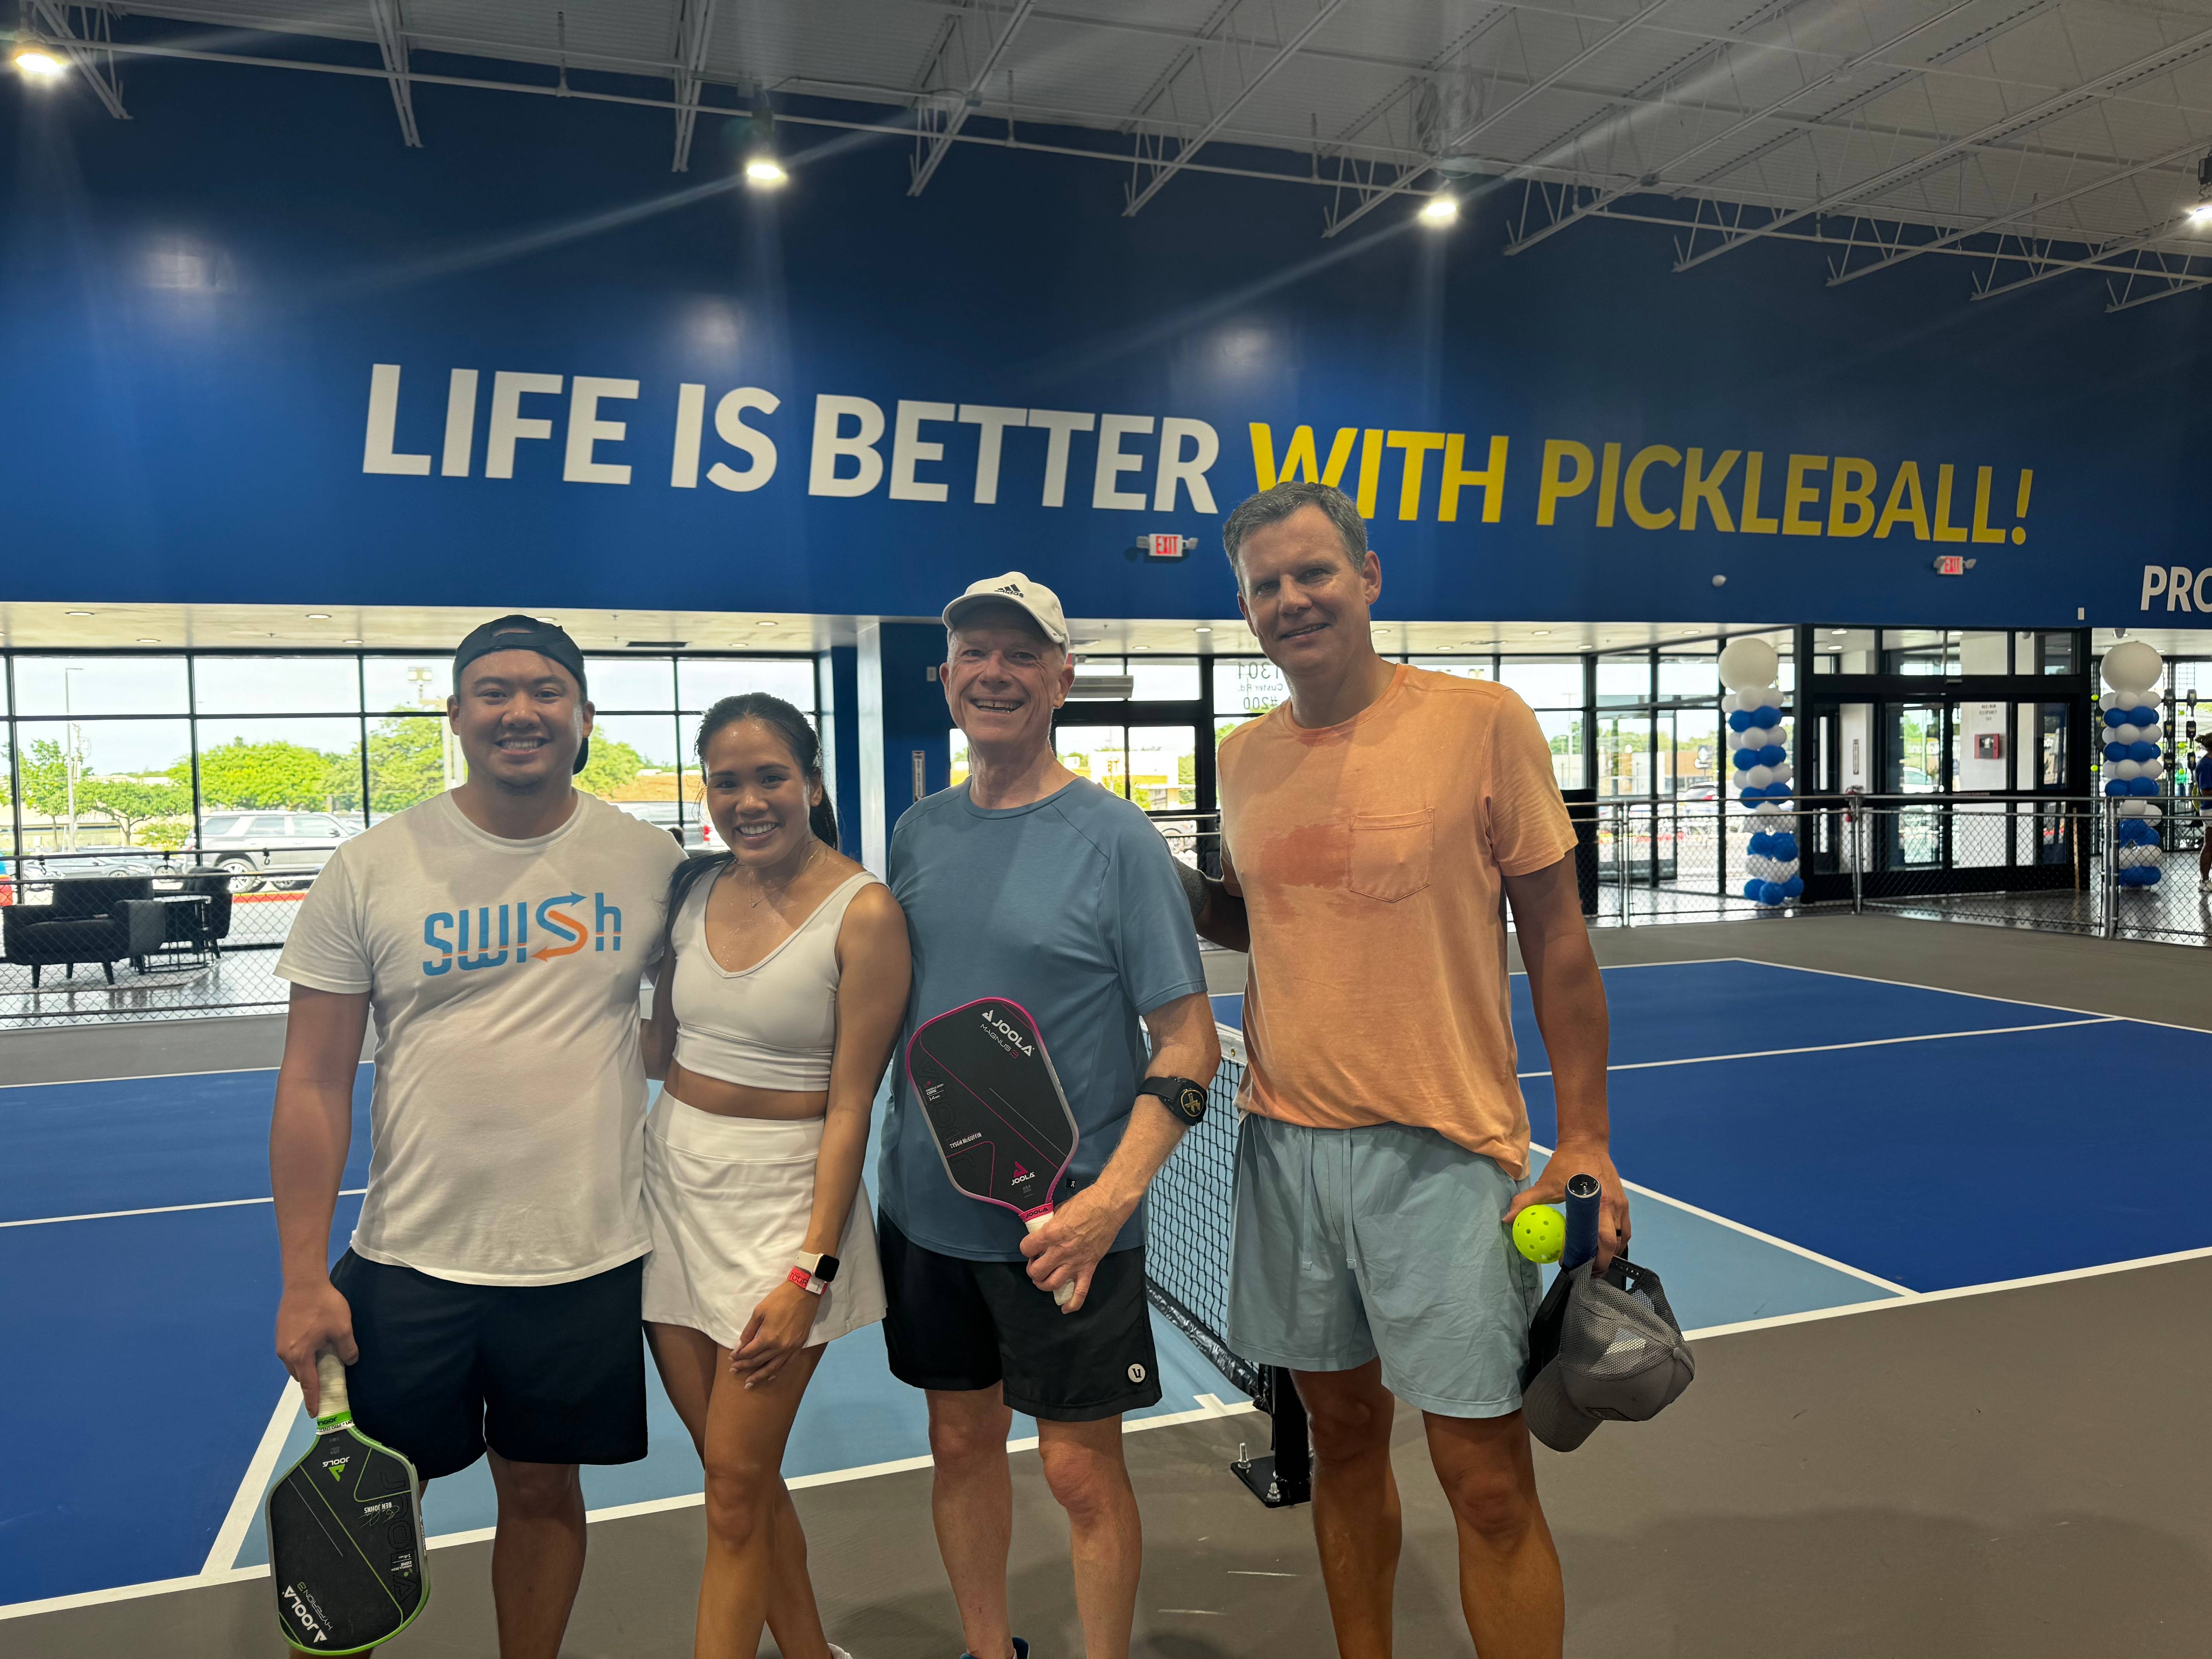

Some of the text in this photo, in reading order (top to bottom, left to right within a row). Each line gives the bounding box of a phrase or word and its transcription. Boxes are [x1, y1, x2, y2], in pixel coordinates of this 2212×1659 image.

[363, 364, 2033, 545] LIFE IS BETTER WITH PICKLEBALL!
[1156, 536, 1178, 555] EXIT
[1944, 557, 1960, 573] EXIT
[980, 1024, 1019, 1058] MAGNUS 3
[991, 1019, 1032, 1057] JOOLA
[949, 1132, 982, 1149] TYSON McGUFFIN
[1011, 1172, 1036, 1186] JOOLA
[1026, 1207, 1048, 1218] JOOLA
[323, 1456, 350, 1467] JOOLA
[364, 1504, 381, 1514] JOHNS
[284, 1585, 319, 1631] JOOLA
[297, 1582, 333, 1630] HYPERION 3
